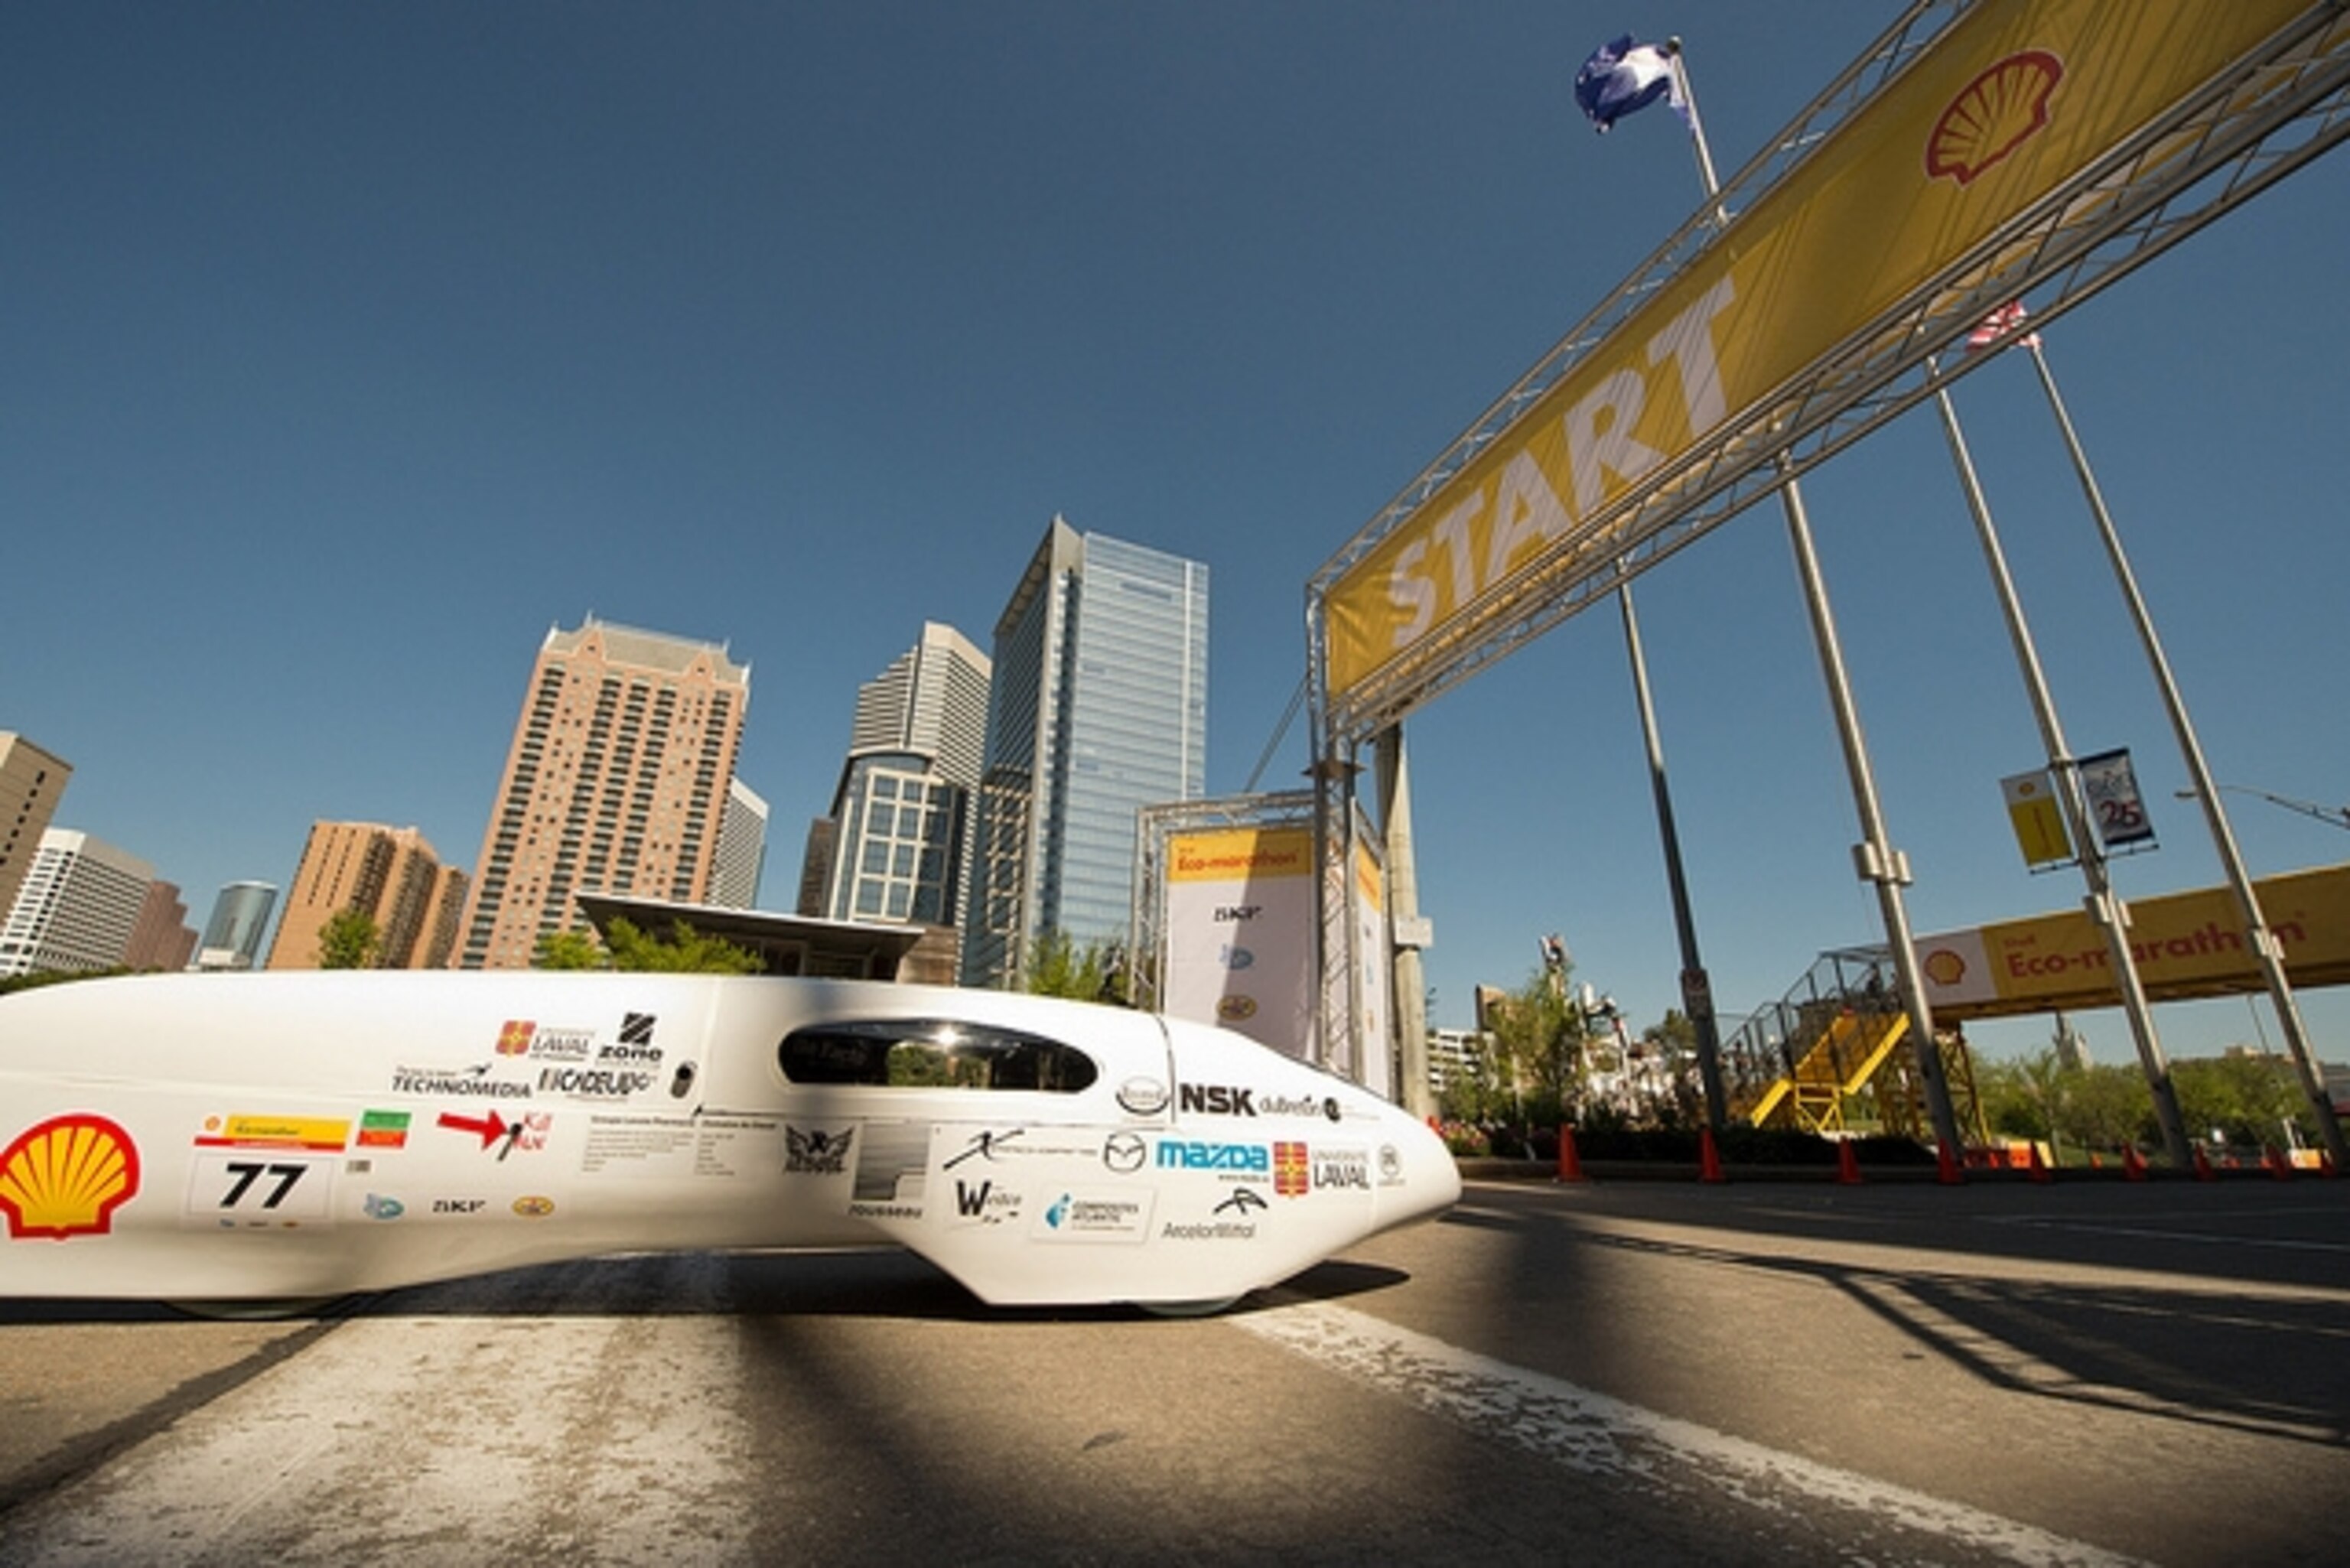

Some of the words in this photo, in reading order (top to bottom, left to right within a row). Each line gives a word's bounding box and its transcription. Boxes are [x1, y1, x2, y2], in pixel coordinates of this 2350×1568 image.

[1387, 274, 1736, 648] START
[2006, 922, 2307, 978] Eco-marathn
[391, 1074, 532, 1099] TECHNOMEDIA
[1179, 1083, 1257, 1117] NSK
[1156, 1141, 1269, 1173] mazda
[220, 1162, 309, 1209] 77
[1313, 1164, 1372, 1190] LAVAL
